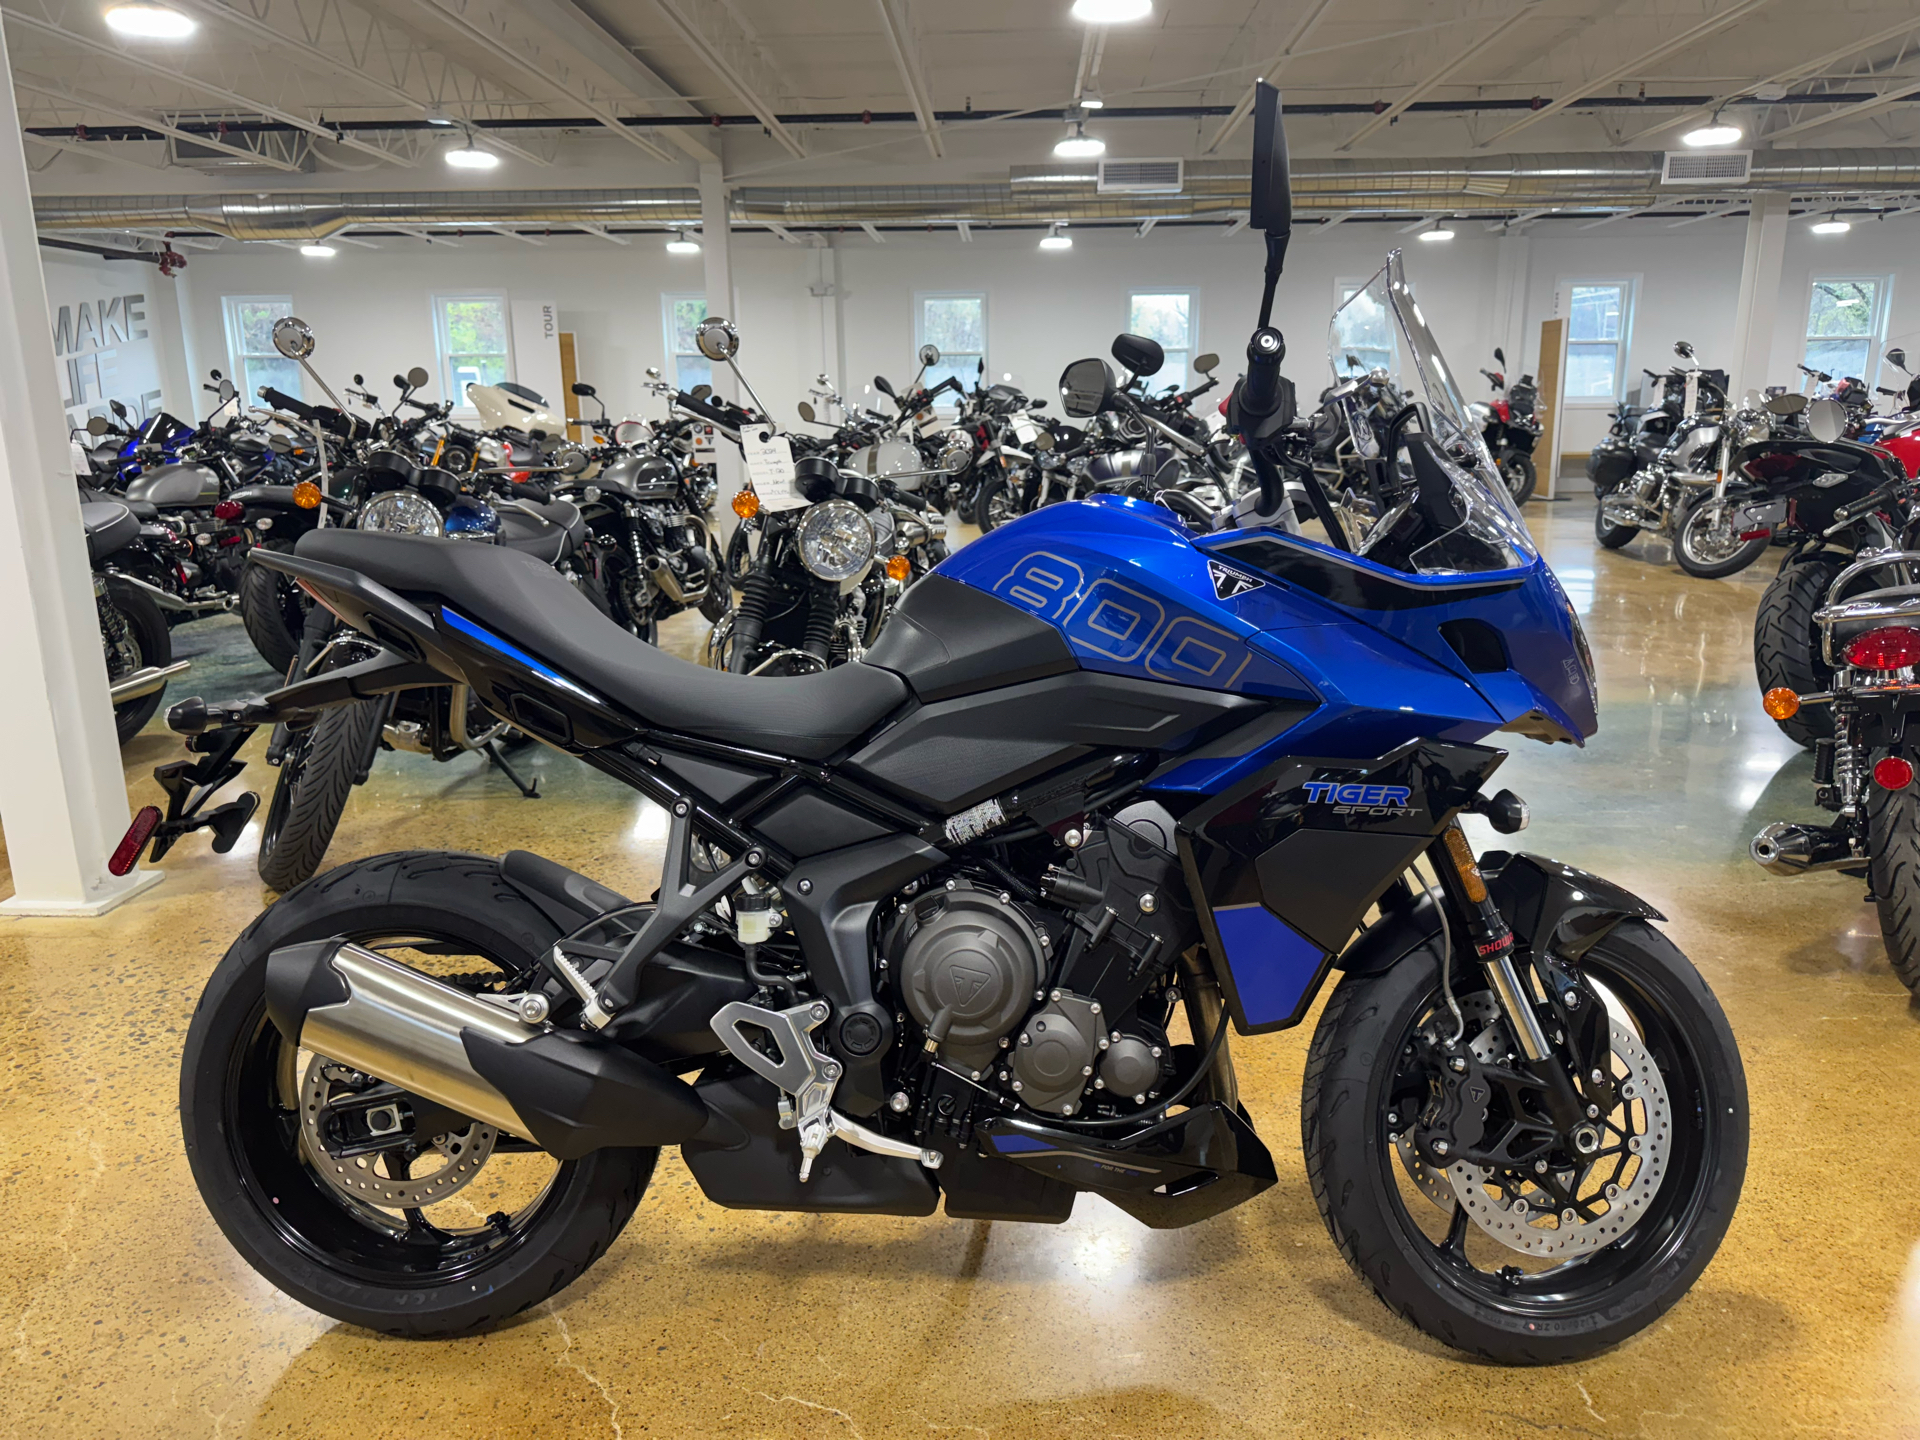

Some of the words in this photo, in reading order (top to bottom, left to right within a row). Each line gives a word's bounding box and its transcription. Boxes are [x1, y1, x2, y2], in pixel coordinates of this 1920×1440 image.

[542, 305, 554, 340] TOUR
[64, 349, 122, 409] IFE
[1218, 564, 1253, 583] TRIUMPH
[992, 551, 1252, 688] 800
[1302, 781, 1411, 807] TIGER
[1332, 805, 1423, 817] SPORT
[1478, 931, 1515, 956] SHOWA
